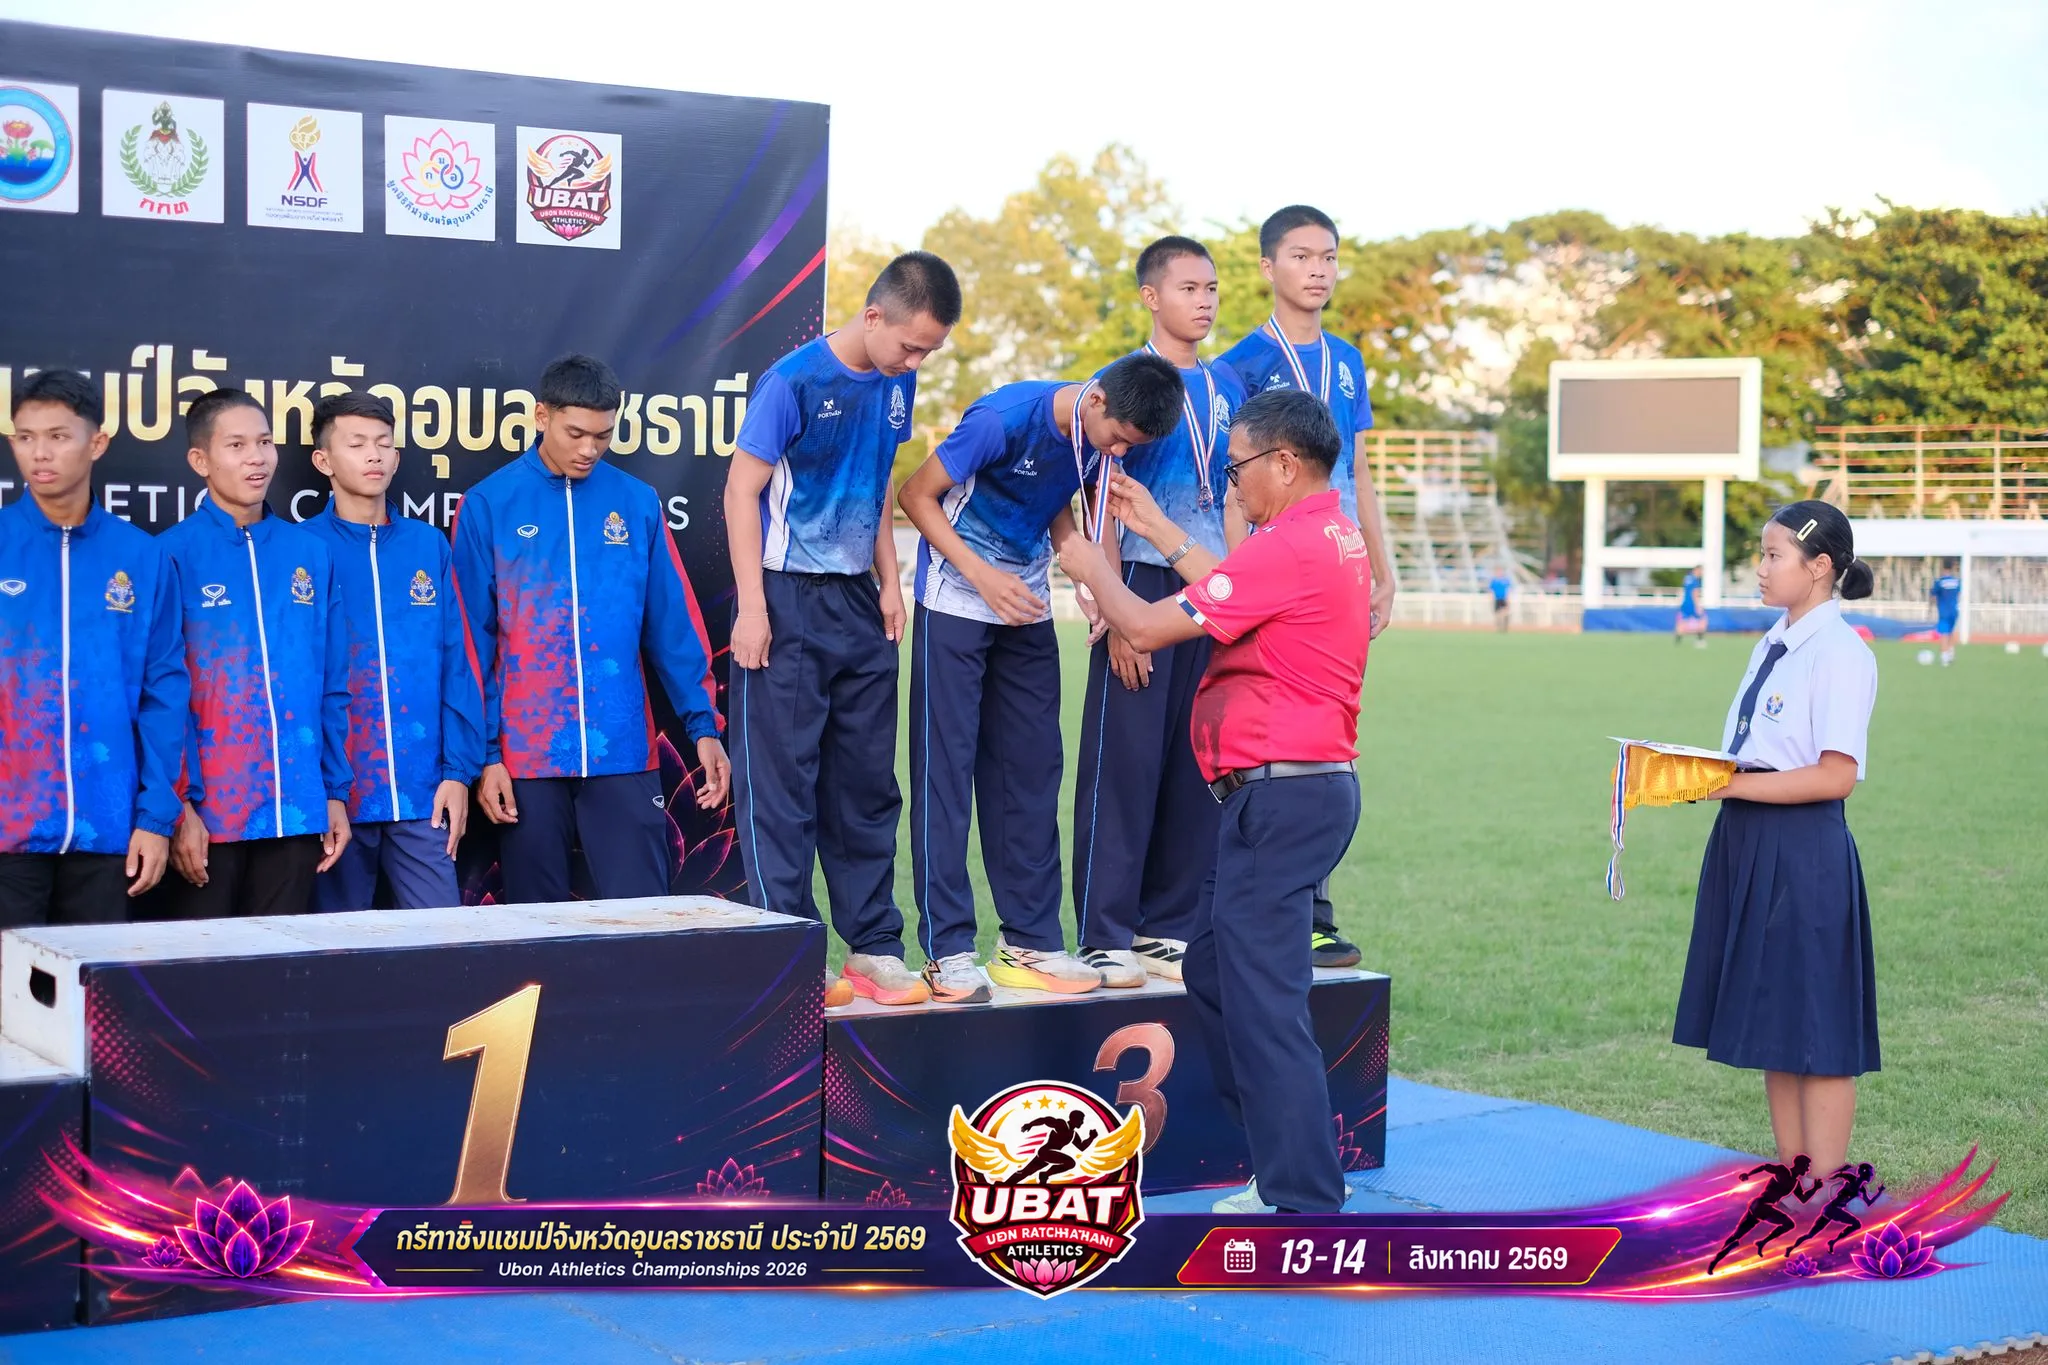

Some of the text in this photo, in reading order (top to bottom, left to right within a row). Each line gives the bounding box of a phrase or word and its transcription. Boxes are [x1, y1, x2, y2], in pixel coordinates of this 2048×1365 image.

[281, 194, 328, 208] NSDF
[533, 188, 605, 212] UBAT
[539, 209, 601, 222] UBON RATCHATHANI
[551, 216, 587, 225] ATHLETICS
[443, 984, 541, 1206] 1
[1093, 1022, 1176, 1157] 3
